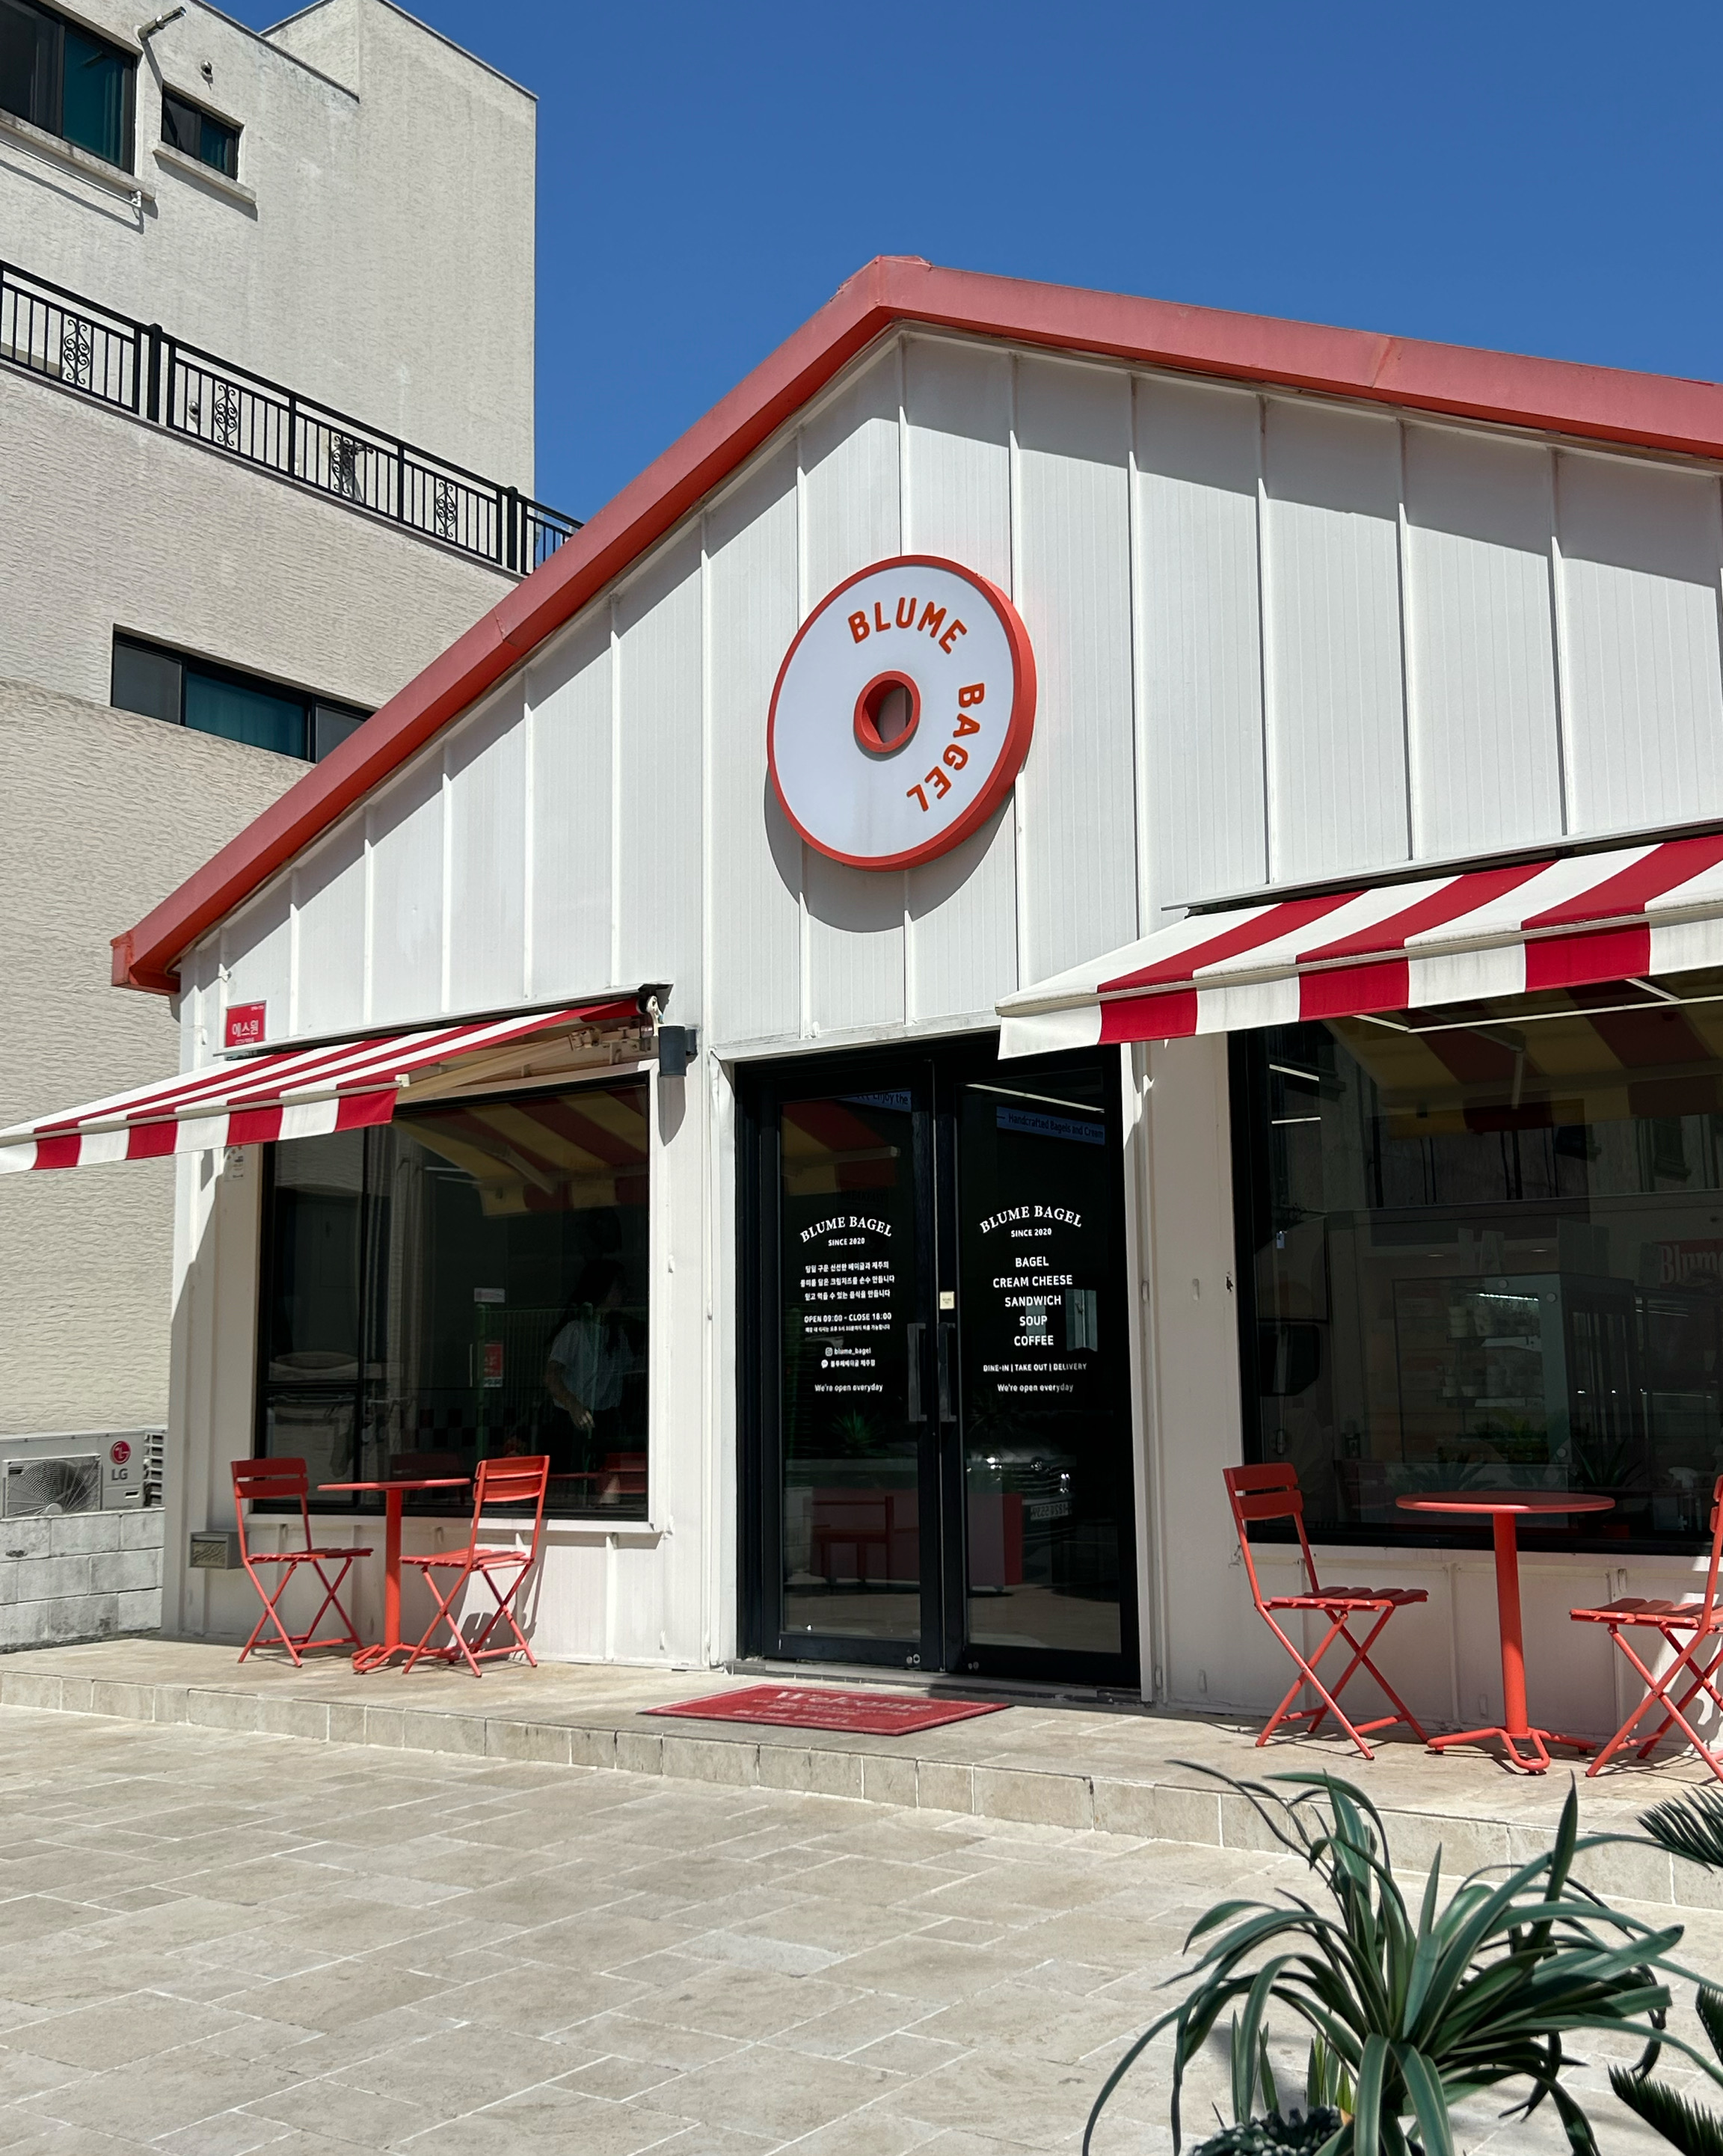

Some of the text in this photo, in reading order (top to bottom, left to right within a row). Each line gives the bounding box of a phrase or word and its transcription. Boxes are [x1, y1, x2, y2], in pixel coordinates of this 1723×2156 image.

[848, 597, 985, 813] BLUME BAGEL
[1008, 1113, 1104, 1138] Handcrafted Bagels and Cream
[980, 1205, 1082, 1234] BLUME BAGEL
[799, 1216, 892, 1243] BLUME BAGEL
[1010, 1228, 1052, 1238] SINCE 2020
[828, 1238, 848, 1247] SINCE
[1015, 1256, 1049, 1268] BAGEL
[992, 1274, 1073, 1288] CREAM CHEESE
[1004, 1294, 1061, 1307] SANDWICH
[804, 1315, 822, 1324] OPEN
[823, 1314, 843, 1323] 09:00
[849, 1312, 870, 1322] CLOSE
[872, 1312, 892, 1321] 18:00
[1019, 1315, 1048, 1327] SOUP
[1014, 1335, 1054, 1346] COFFEE
[1015, 1363, 1032, 1372] TAKE
[1034, 1363, 1048, 1372] OUT
[1053, 1363, 1087, 1372] DELIVERY
[834, 1384, 852, 1393] open
[853, 1383, 883, 1392] everyday
[997, 1383, 1074, 1393] We're open everyday
[111, 1468, 129, 1481] LG
